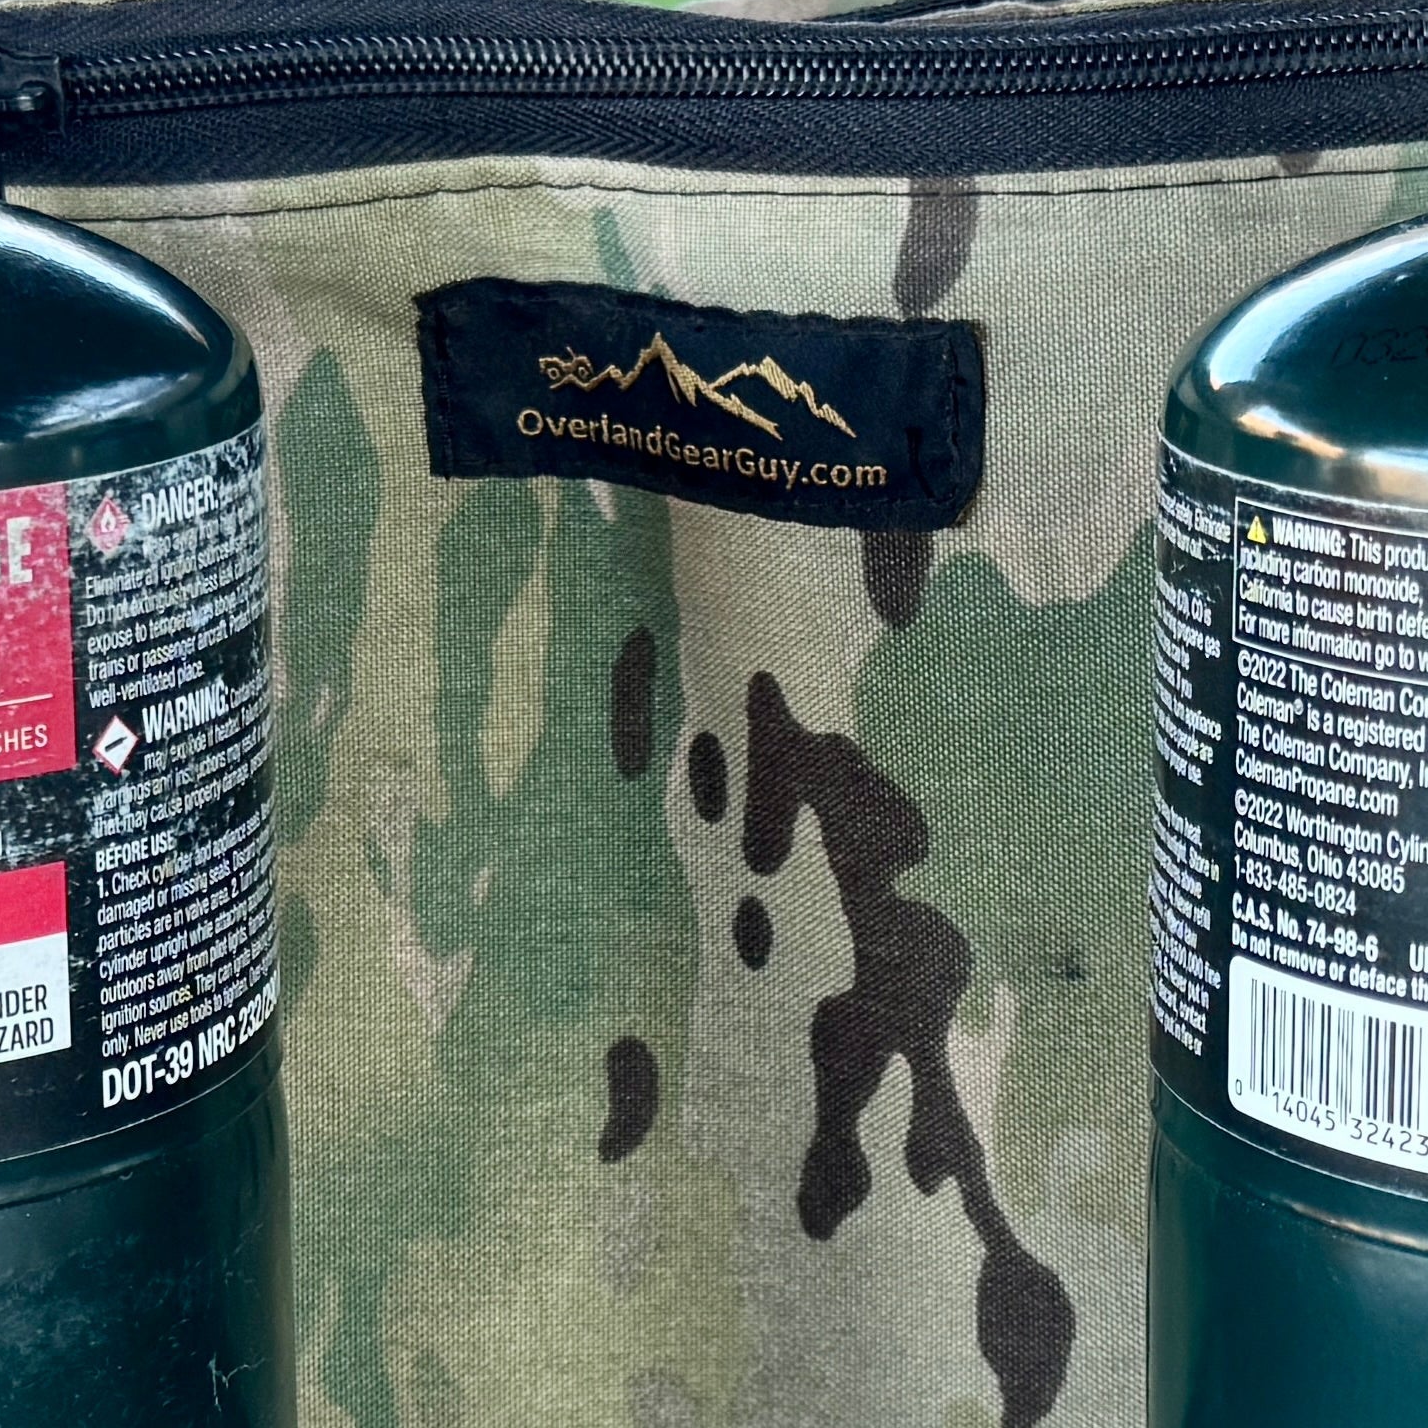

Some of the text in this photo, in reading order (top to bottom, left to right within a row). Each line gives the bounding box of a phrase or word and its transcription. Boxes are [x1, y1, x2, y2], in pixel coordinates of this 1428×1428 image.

[516, 407, 888, 490] OverlandGearGuy.com
[141, 475, 219, 528] DANGER:
[1273, 517, 1345, 558] WARNING:
[1349, 533, 1381, 564] This
[1239, 573, 1292, 609] California
[1296, 591, 1308, 616] to
[1311, 599, 1353, 626] cause
[1357, 603, 1391, 633] birth
[1239, 605, 1256, 634] For
[1259, 620, 1289, 644] more
[1292, 621, 1371, 662] information
[1375, 646, 1395, 670] go
[1399, 643, 1414, 671] to
[143, 680, 229, 743] WARNING:
[1289, 665, 1317, 696] The
[1322, 672, 1395, 712] Coleman
[1236, 714, 1260, 746] The
[1262, 724, 1324, 766] Coleman
[1329, 743, 1413, 789] Company,
[1236, 748, 1398, 817] ColemanPropane.com
[96, 842, 149, 872] BEFORE
[1234, 820, 1404, 893] Columbus, Ohio 43085
[1286, 805, 1382, 855] Worthington
[1234, 854, 1356, 915] 1-833-485-0824
[1232, 892, 1273, 932] C.A.S.
[1277, 908, 1302, 941] No.
[1306, 919, 1378, 962] 74-98-6
[102, 1012, 188, 1057] only. Never use
[103, 1015, 235, 1108] DOT-39 NRC
[1235, 1079, 1242, 1097] 0
[1273, 1092, 1335, 1132] 14045
[1350, 1118, 1428, 1156] 32423
